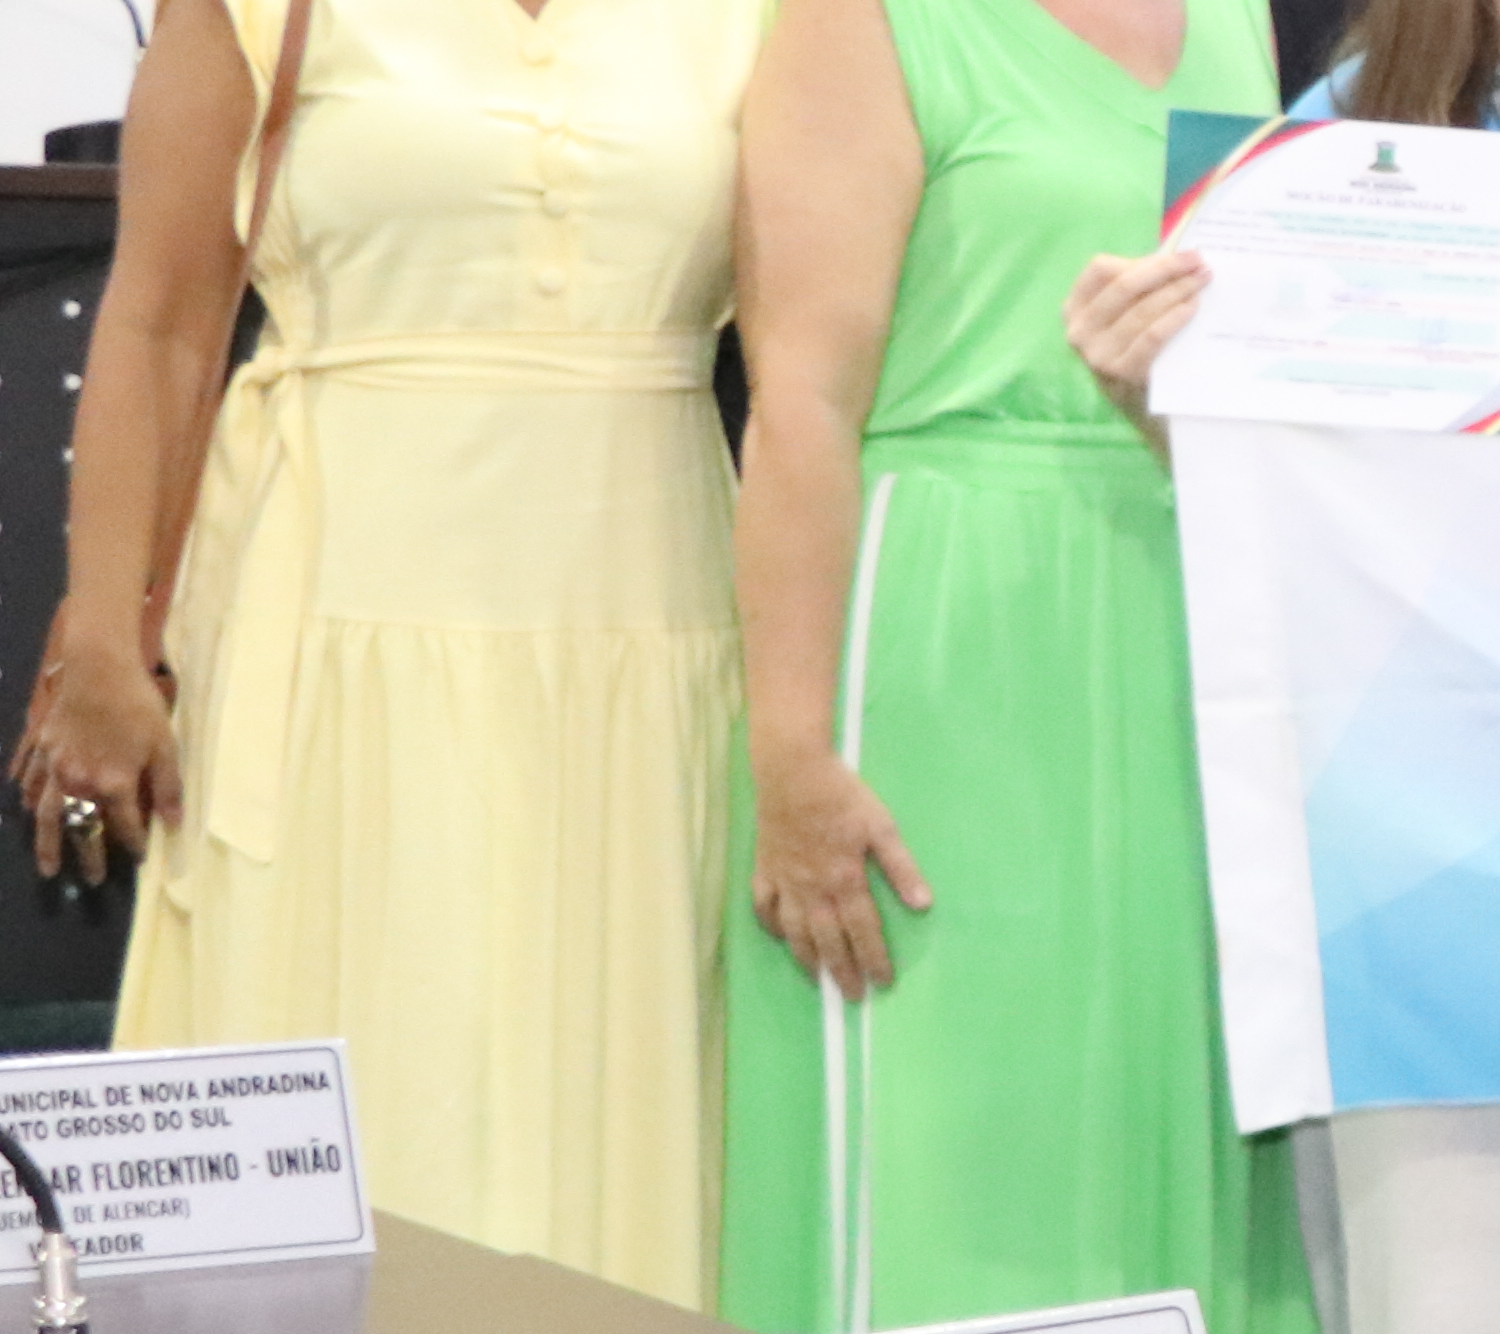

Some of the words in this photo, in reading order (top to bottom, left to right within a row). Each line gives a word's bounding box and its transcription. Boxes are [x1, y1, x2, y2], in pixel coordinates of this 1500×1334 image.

[0, 1088, 98, 1114] UNICIPAL
[106, 1085, 132, 1107] DE
[140, 1079, 199, 1103] NOVA
[208, 1070, 331, 1098] ANDRADINA
[56, 1112, 146, 1139] GROSSO
[154, 1108, 183, 1132] DO
[190, 1106, 232, 1128] SUL
[94, 1151, 241, 1192] FLORENTINO
[267, 1136, 342, 1178] UNIÃO
[73, 1201, 95, 1224] DE
[103, 1196, 191, 1223] ALENCAR)
[29, 1232, 145, 1263] VEADOR
